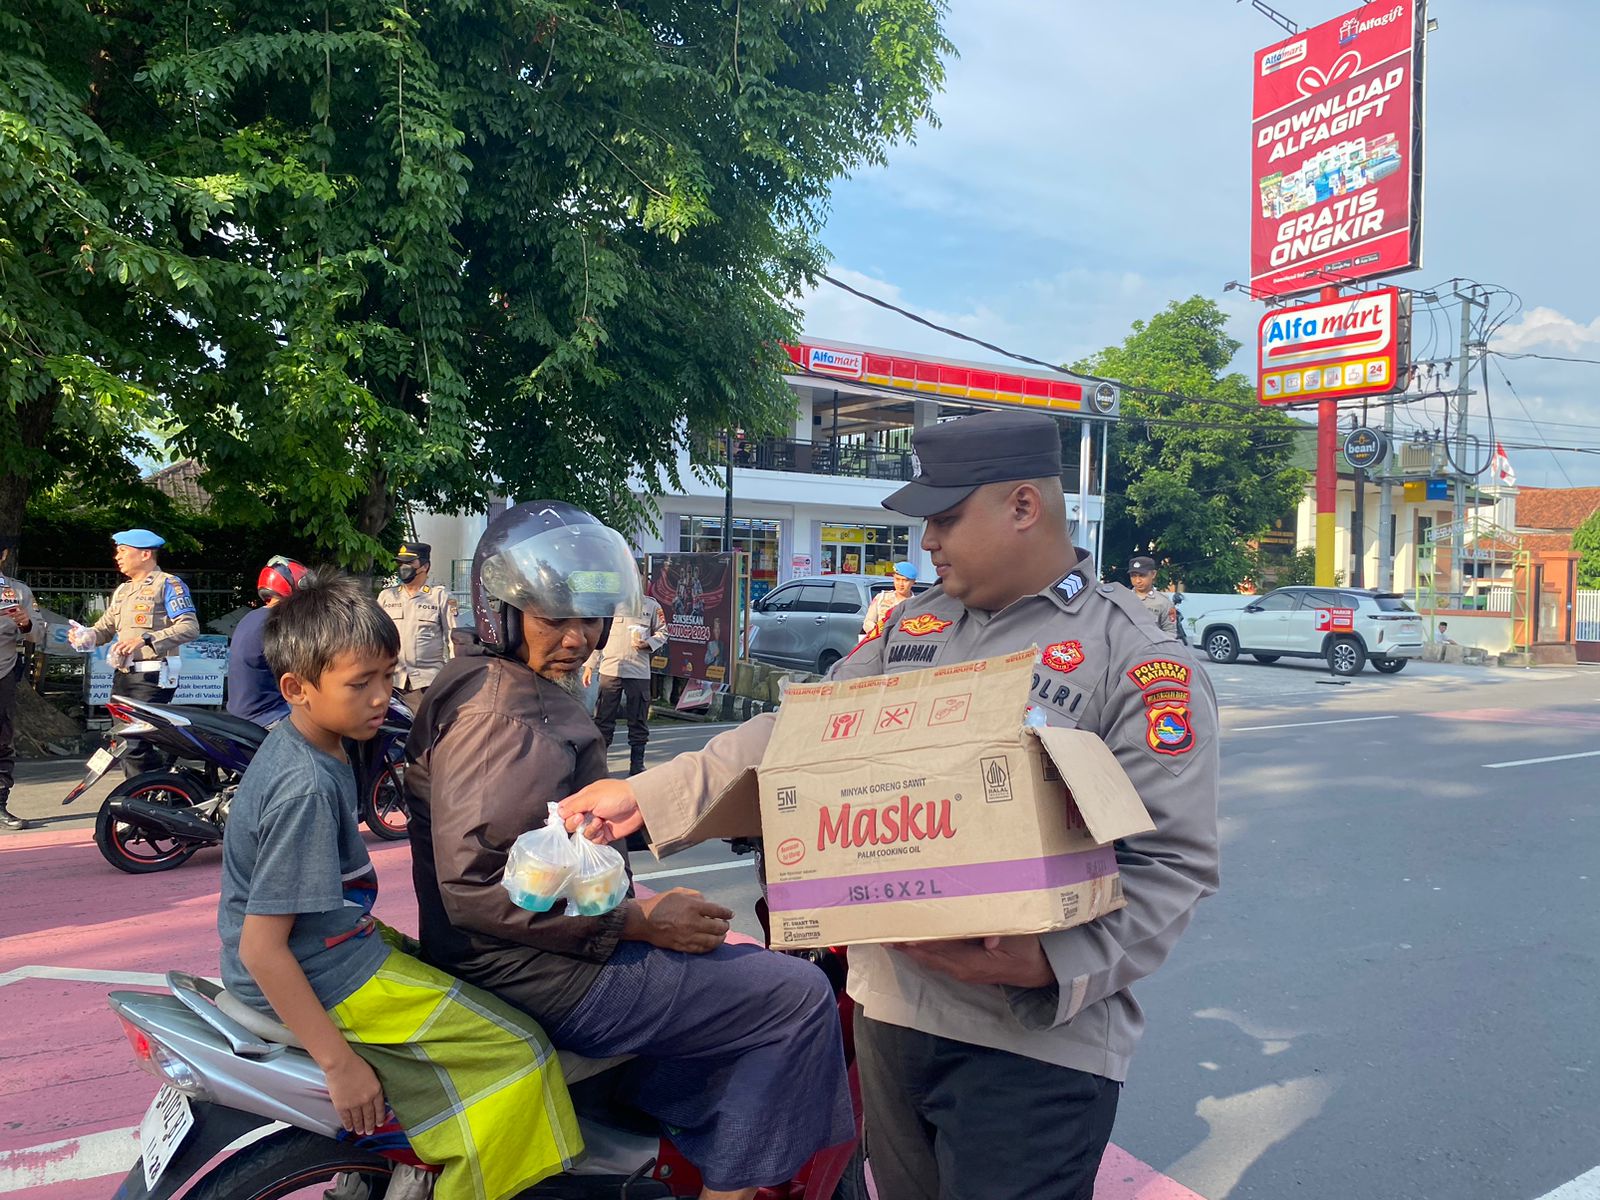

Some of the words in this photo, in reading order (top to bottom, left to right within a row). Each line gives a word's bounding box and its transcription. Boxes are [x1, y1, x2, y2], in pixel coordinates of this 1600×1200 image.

[1358, 5, 1404, 34] Alfagift
[1265, 44, 1304, 66] Alfamart
[1257, 67, 1404, 148] DOWNLOAD
[1268, 94, 1391, 163] ALFAGIFT
[1277, 188, 1378, 242] GRATIS
[1270, 208, 1385, 267] ONGKIR
[1268, 304, 1384, 343] Alfamart
[812, 350, 860, 367] Alfamart
[1370, 364, 1383, 374] 24
[672, 614, 704, 625] SUKSESKAN
[1315, 609, 1330, 629] P
[1134, 662, 1187, 678] POLRESTA
[1140, 669, 1185, 685] MATARAM
[777, 789, 797, 807] SNI
[841, 785, 868, 798] MINYAK
[869, 782, 901, 793] GORENG
[903, 777, 927, 789] SAWIT
[817, 795, 957, 851] Masku
[857, 850, 876, 860] PALM
[876, 847, 909, 858] COOKING
[909, 845, 921, 854] OIL
[849, 885, 869, 902] ISI
[884, 886, 894, 899] 6
[915, 880, 926, 896] 2
[930, 879, 942, 895] L
